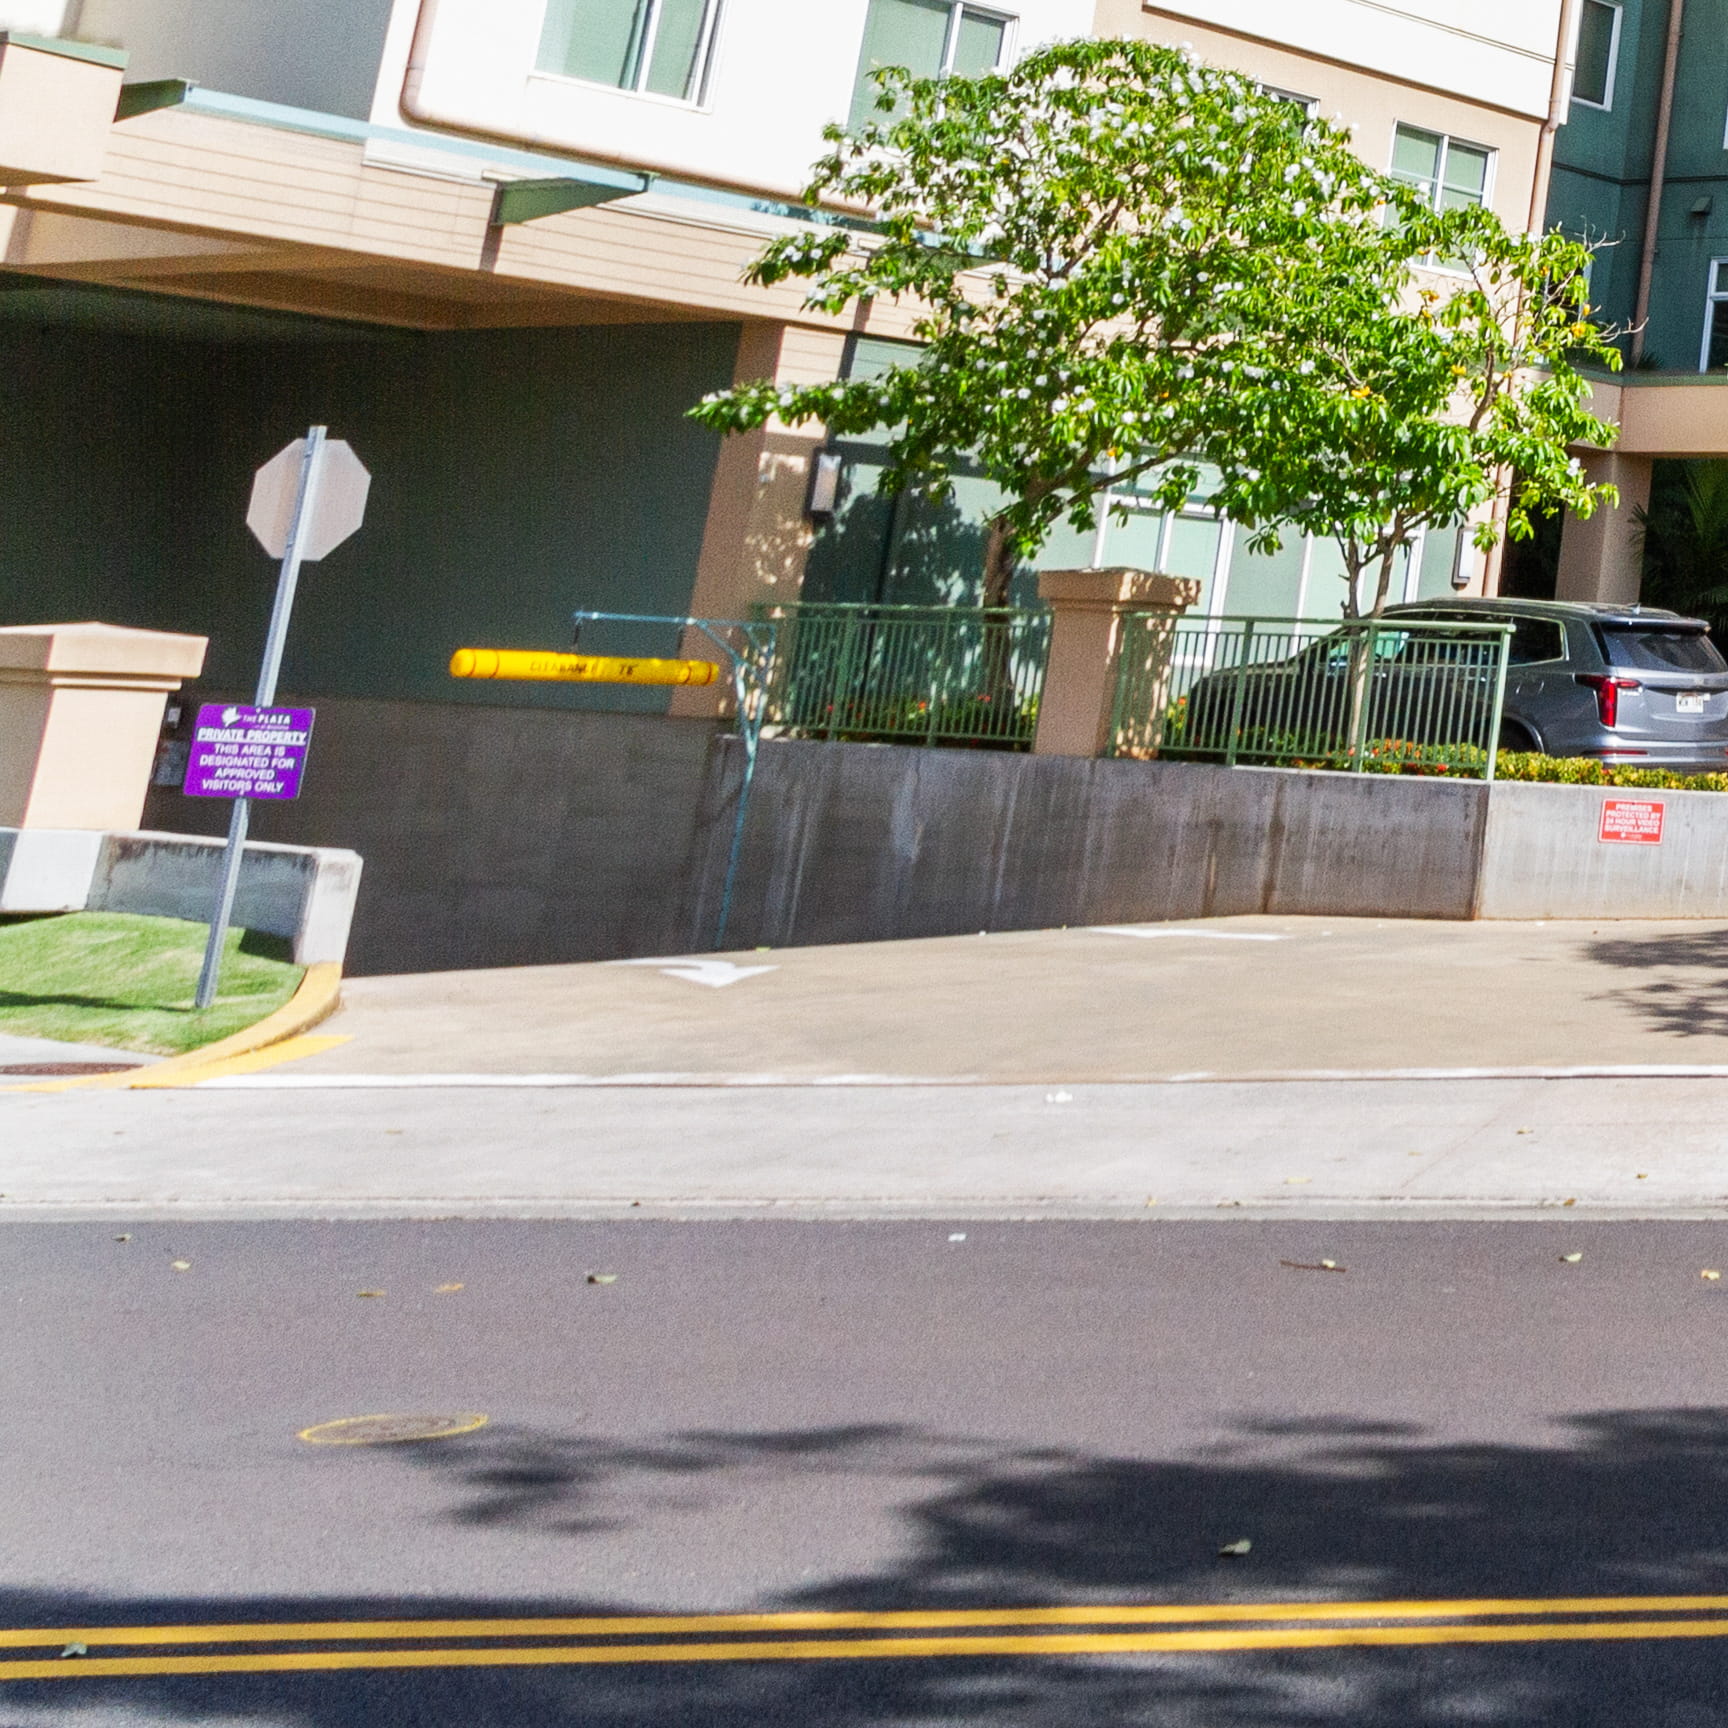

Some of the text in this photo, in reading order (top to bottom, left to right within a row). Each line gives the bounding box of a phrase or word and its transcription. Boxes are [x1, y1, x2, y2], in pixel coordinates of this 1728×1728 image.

[243, 714, 290, 724] THE PLAZA
[197, 728, 306, 745] PRIVATE PROPERTY
[214, 743, 286, 757] THIS AREA IS
[199, 754, 295, 769] DESIGNATED FOR
[214, 767, 275, 780] APPROVED
[202, 779, 284, 793] VISITORS ONLY
[1616, 803, 1652, 811] PREMISES
[1606, 810, 1661, 820] PROTECTED BY
[1605, 817, 1660, 827] 24 HOUR VIDEO
[1604, 825, 1659, 834] SURVEILLANCE
